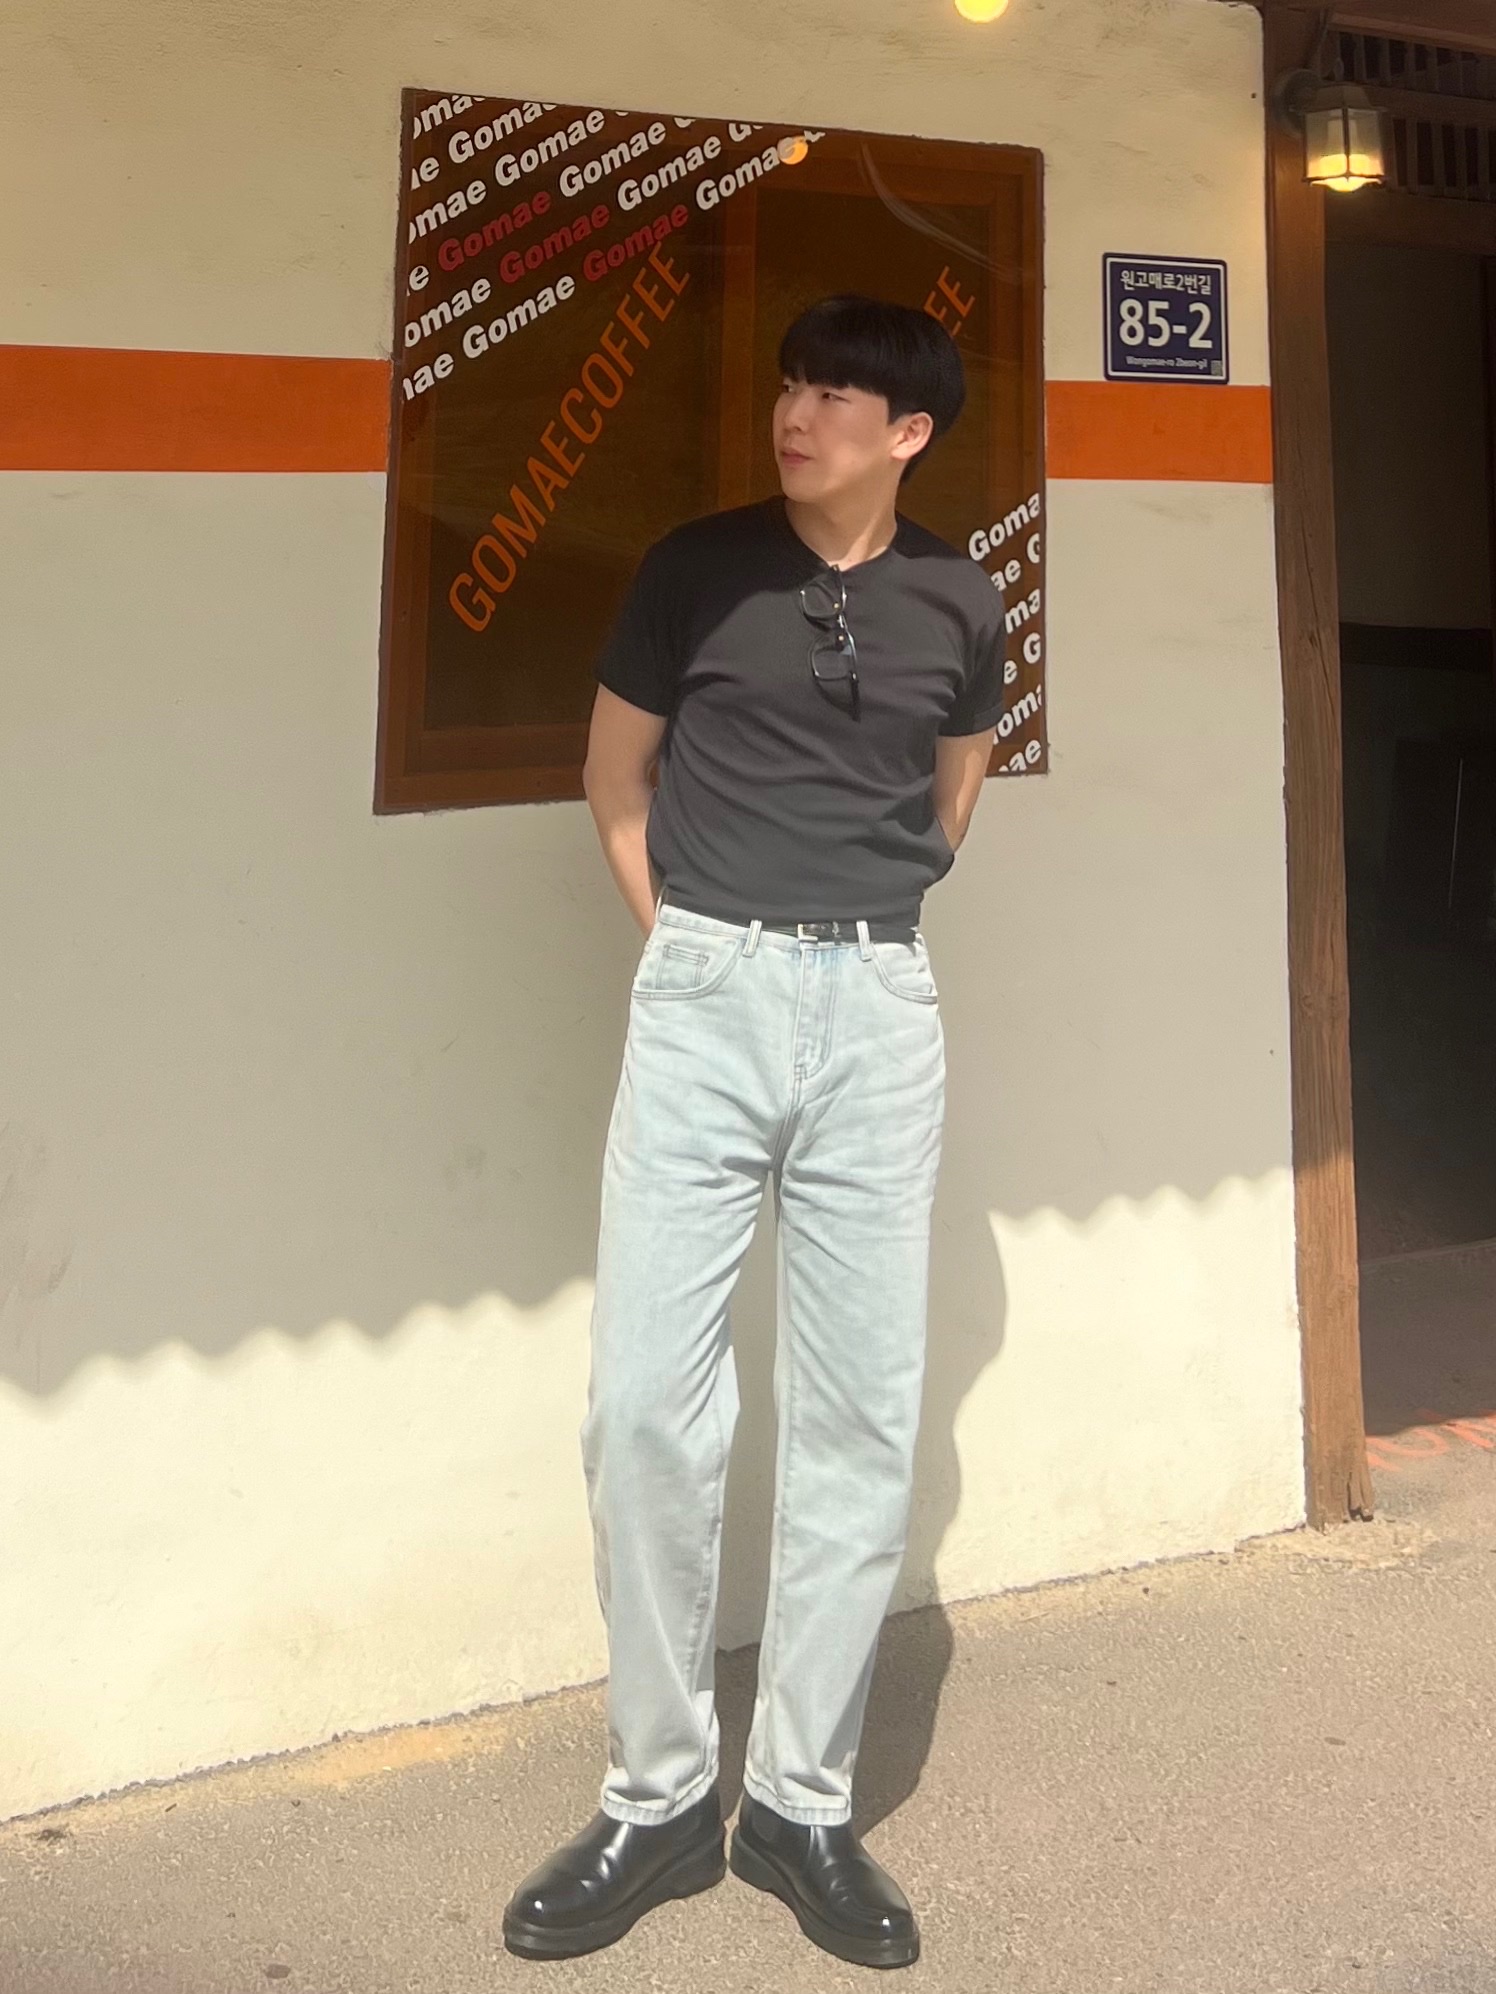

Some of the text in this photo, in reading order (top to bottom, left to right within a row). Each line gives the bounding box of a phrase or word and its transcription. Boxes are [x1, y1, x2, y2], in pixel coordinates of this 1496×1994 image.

[413, 95, 485, 140] ma
[494, 110, 605, 187] Gomae
[438, 191, 551, 271] Gomae
[559, 121, 666, 197] Gomae
[500, 204, 610, 283] Gomae
[617, 135, 722, 211] Gomae
[462, 275, 575, 359] Gomae
[583, 204, 688, 281] Gomae
[1120, 270, 1212, 295] 원고매로2번길
[1119, 298, 1213, 349] 85-2
[449, 241, 690, 632] GOMAECOFFEE
[993, 684, 1042, 745] om
[998, 739, 1041, 772] ae
